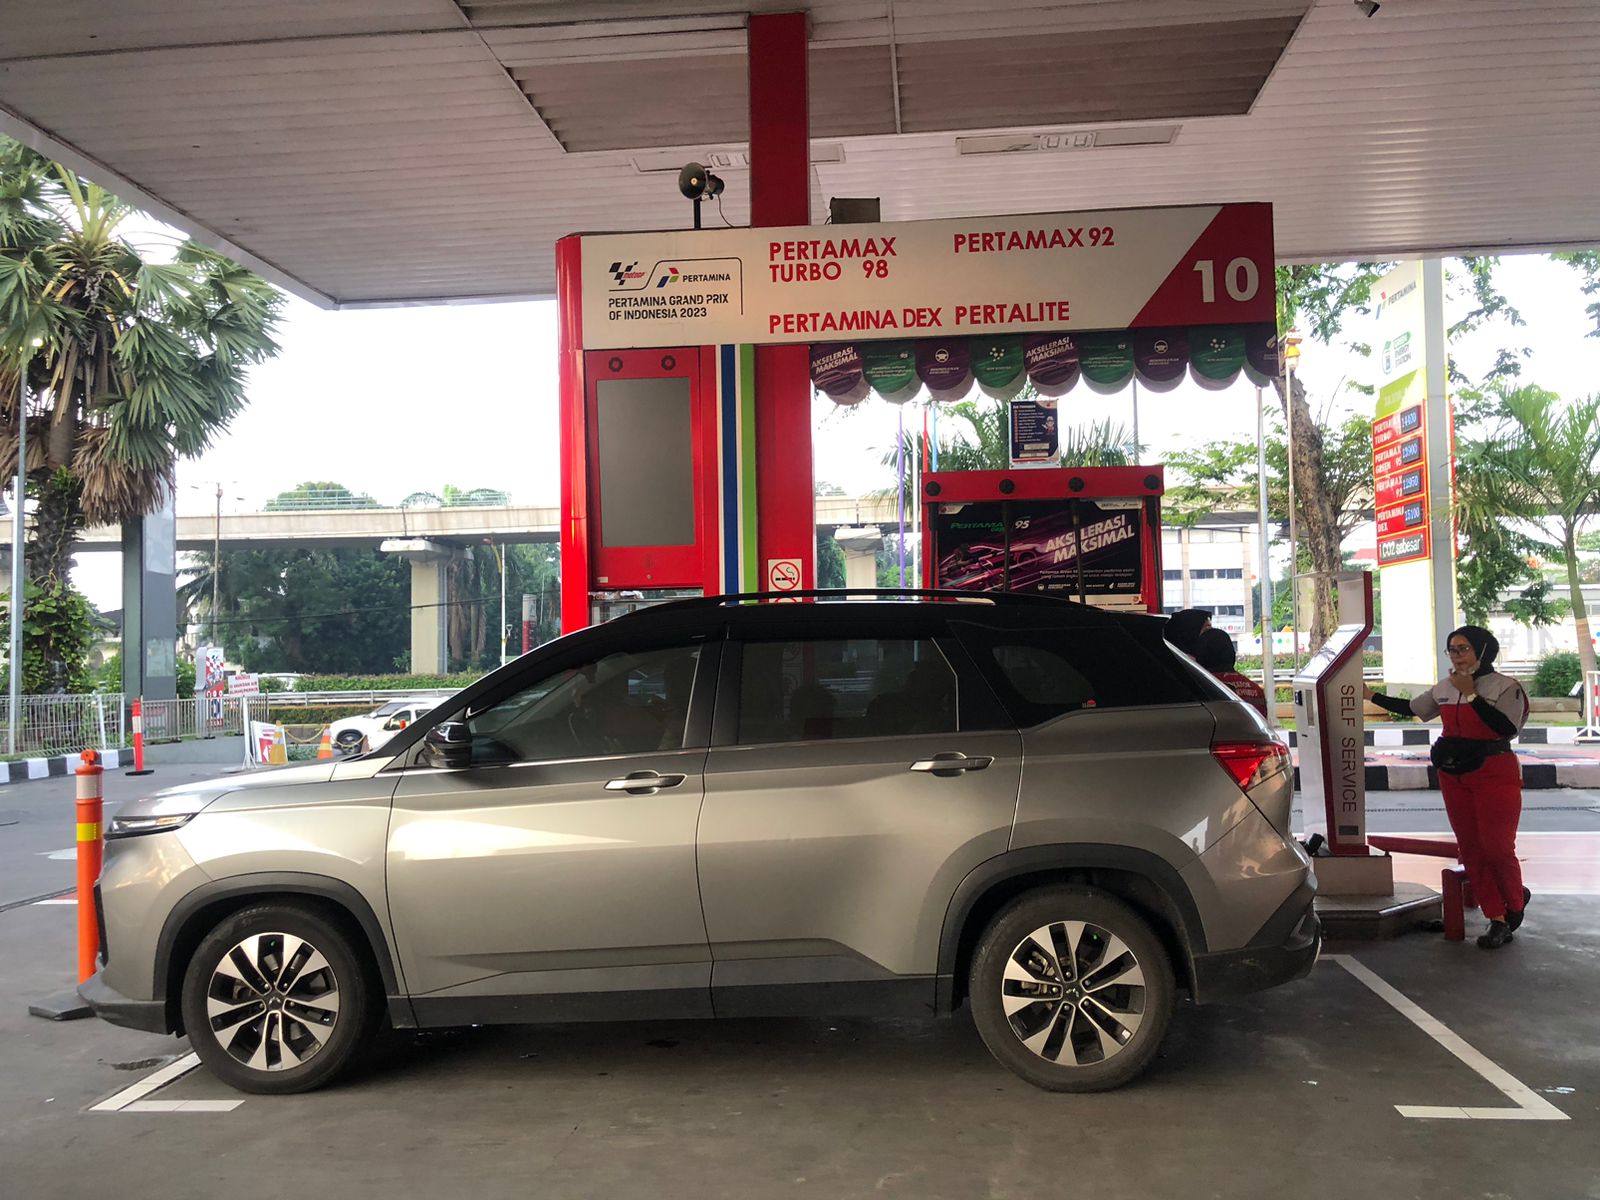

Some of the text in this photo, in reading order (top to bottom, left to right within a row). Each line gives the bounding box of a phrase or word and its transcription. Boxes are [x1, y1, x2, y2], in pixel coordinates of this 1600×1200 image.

[769, 236, 897, 262] PERTAMAX
[954, 226, 1115, 253] PERTAMAX 92
[682, 273, 731, 283] PERTAMINA
[769, 259, 889, 283] TURBO 98
[1193, 256, 1260, 303] 10
[608, 293, 729, 308] PERTAMINA GRAND PRIX
[609, 307, 707, 321] OF INDONESIA 2023
[769, 307, 942, 334] PERTAMINA DEX
[955, 301, 1070, 325] PERTALITE
[811, 346, 854, 369] AKSELERASI
[1025, 336, 1070, 359] AKSELERASI
[1030, 342, 1076, 365] MAKSIMAL
[815, 352, 859, 375] MAKSIMAL
[1375, 444, 1401, 463] PERTAMAX
[1377, 475, 1402, 493] PERTAMAX
[1015, 520, 1030, 529] 95
[1045, 514, 1126, 553] AKSLERASI
[1053, 525, 1135, 564] MAKSIMAL
[1341, 684, 1357, 812] SELF SERVICE
